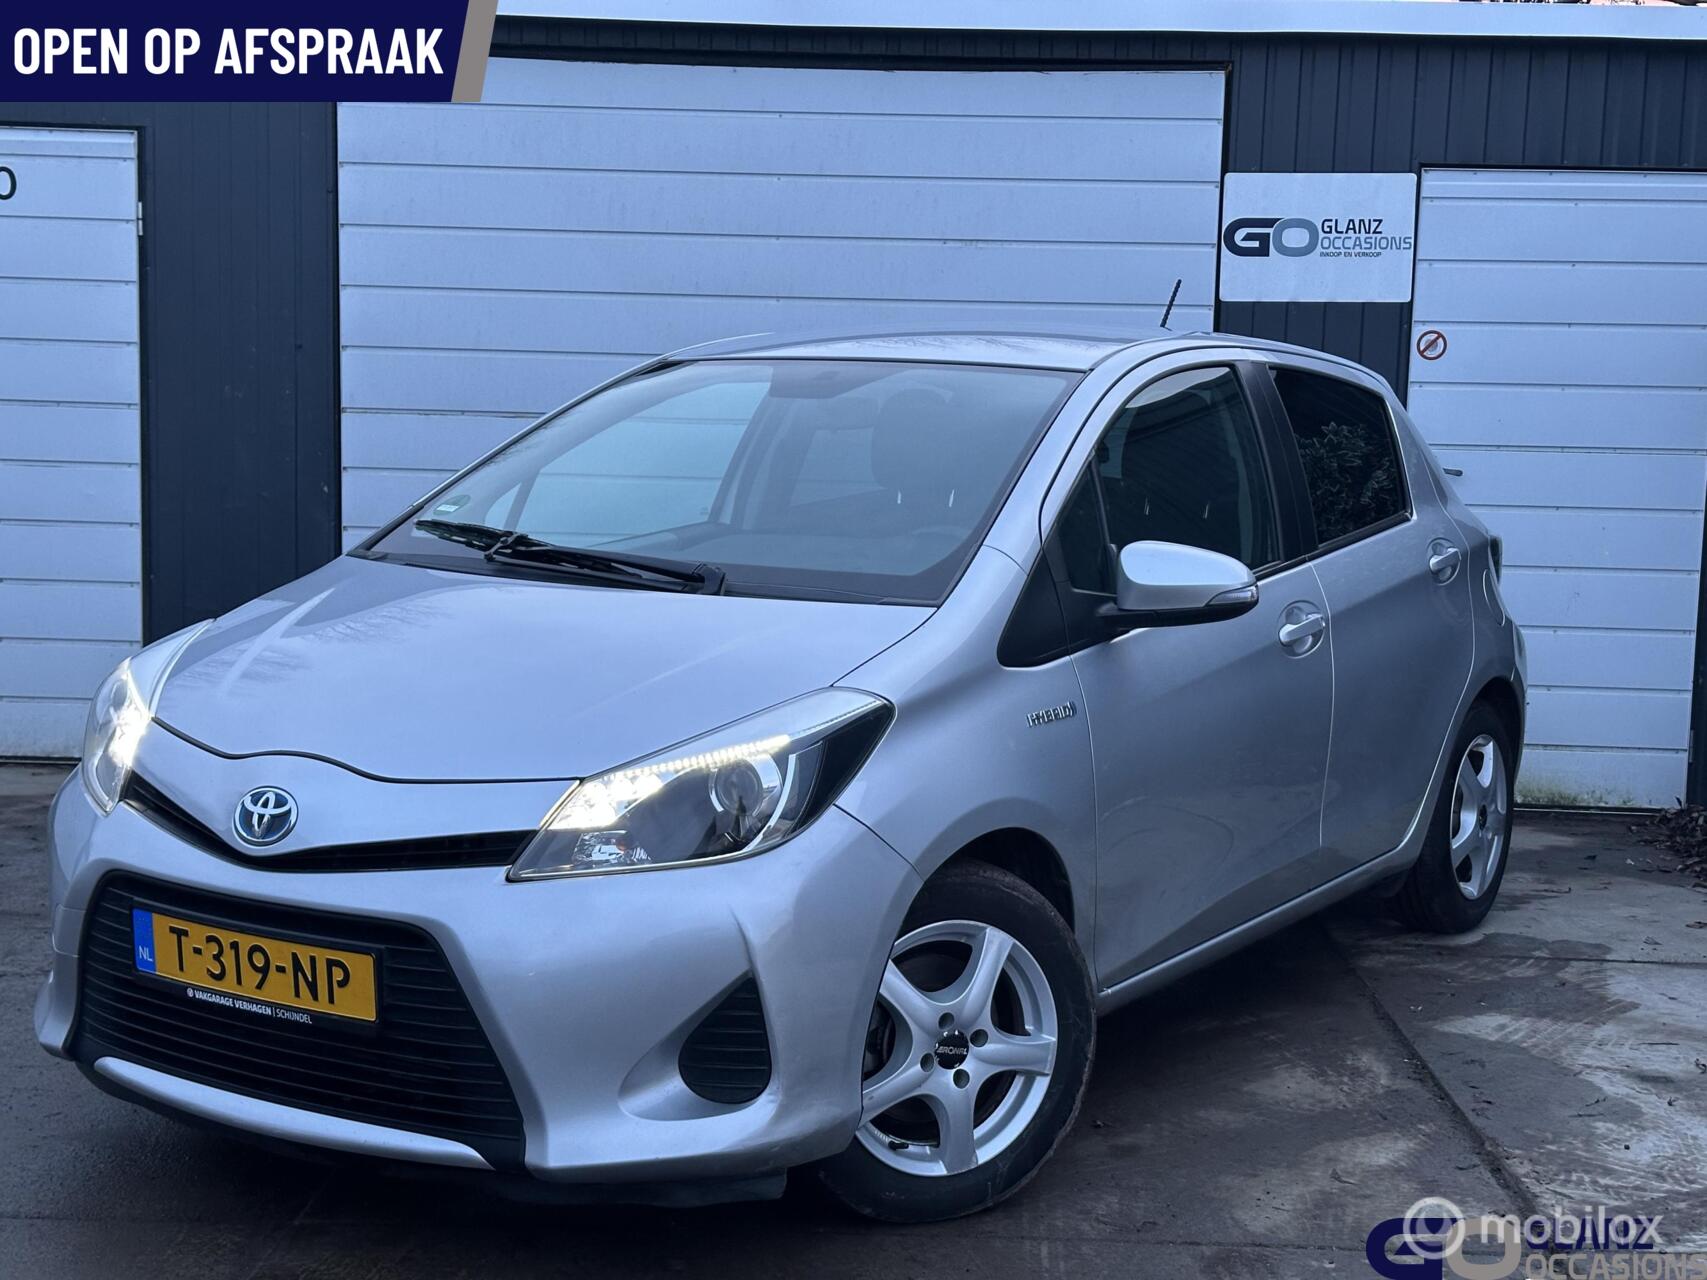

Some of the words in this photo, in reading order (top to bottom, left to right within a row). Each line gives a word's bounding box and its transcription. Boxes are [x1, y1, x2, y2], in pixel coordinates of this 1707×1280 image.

[1223, 217, 1319, 257] GO
[1321, 218, 1383, 235] GLANZ
[1320, 236, 1412, 250] OCCASIONS
[1026, 701, 1077, 728] HYBRID
[138, 946, 153, 962] NL
[168, 925, 351, 1004] T-319-NP
[194, 990, 234, 1008] VAKGARAGE
[234, 999, 272, 1016] VERHAGEN
[276, 1008, 313, 1024] SCHIJNDEL
